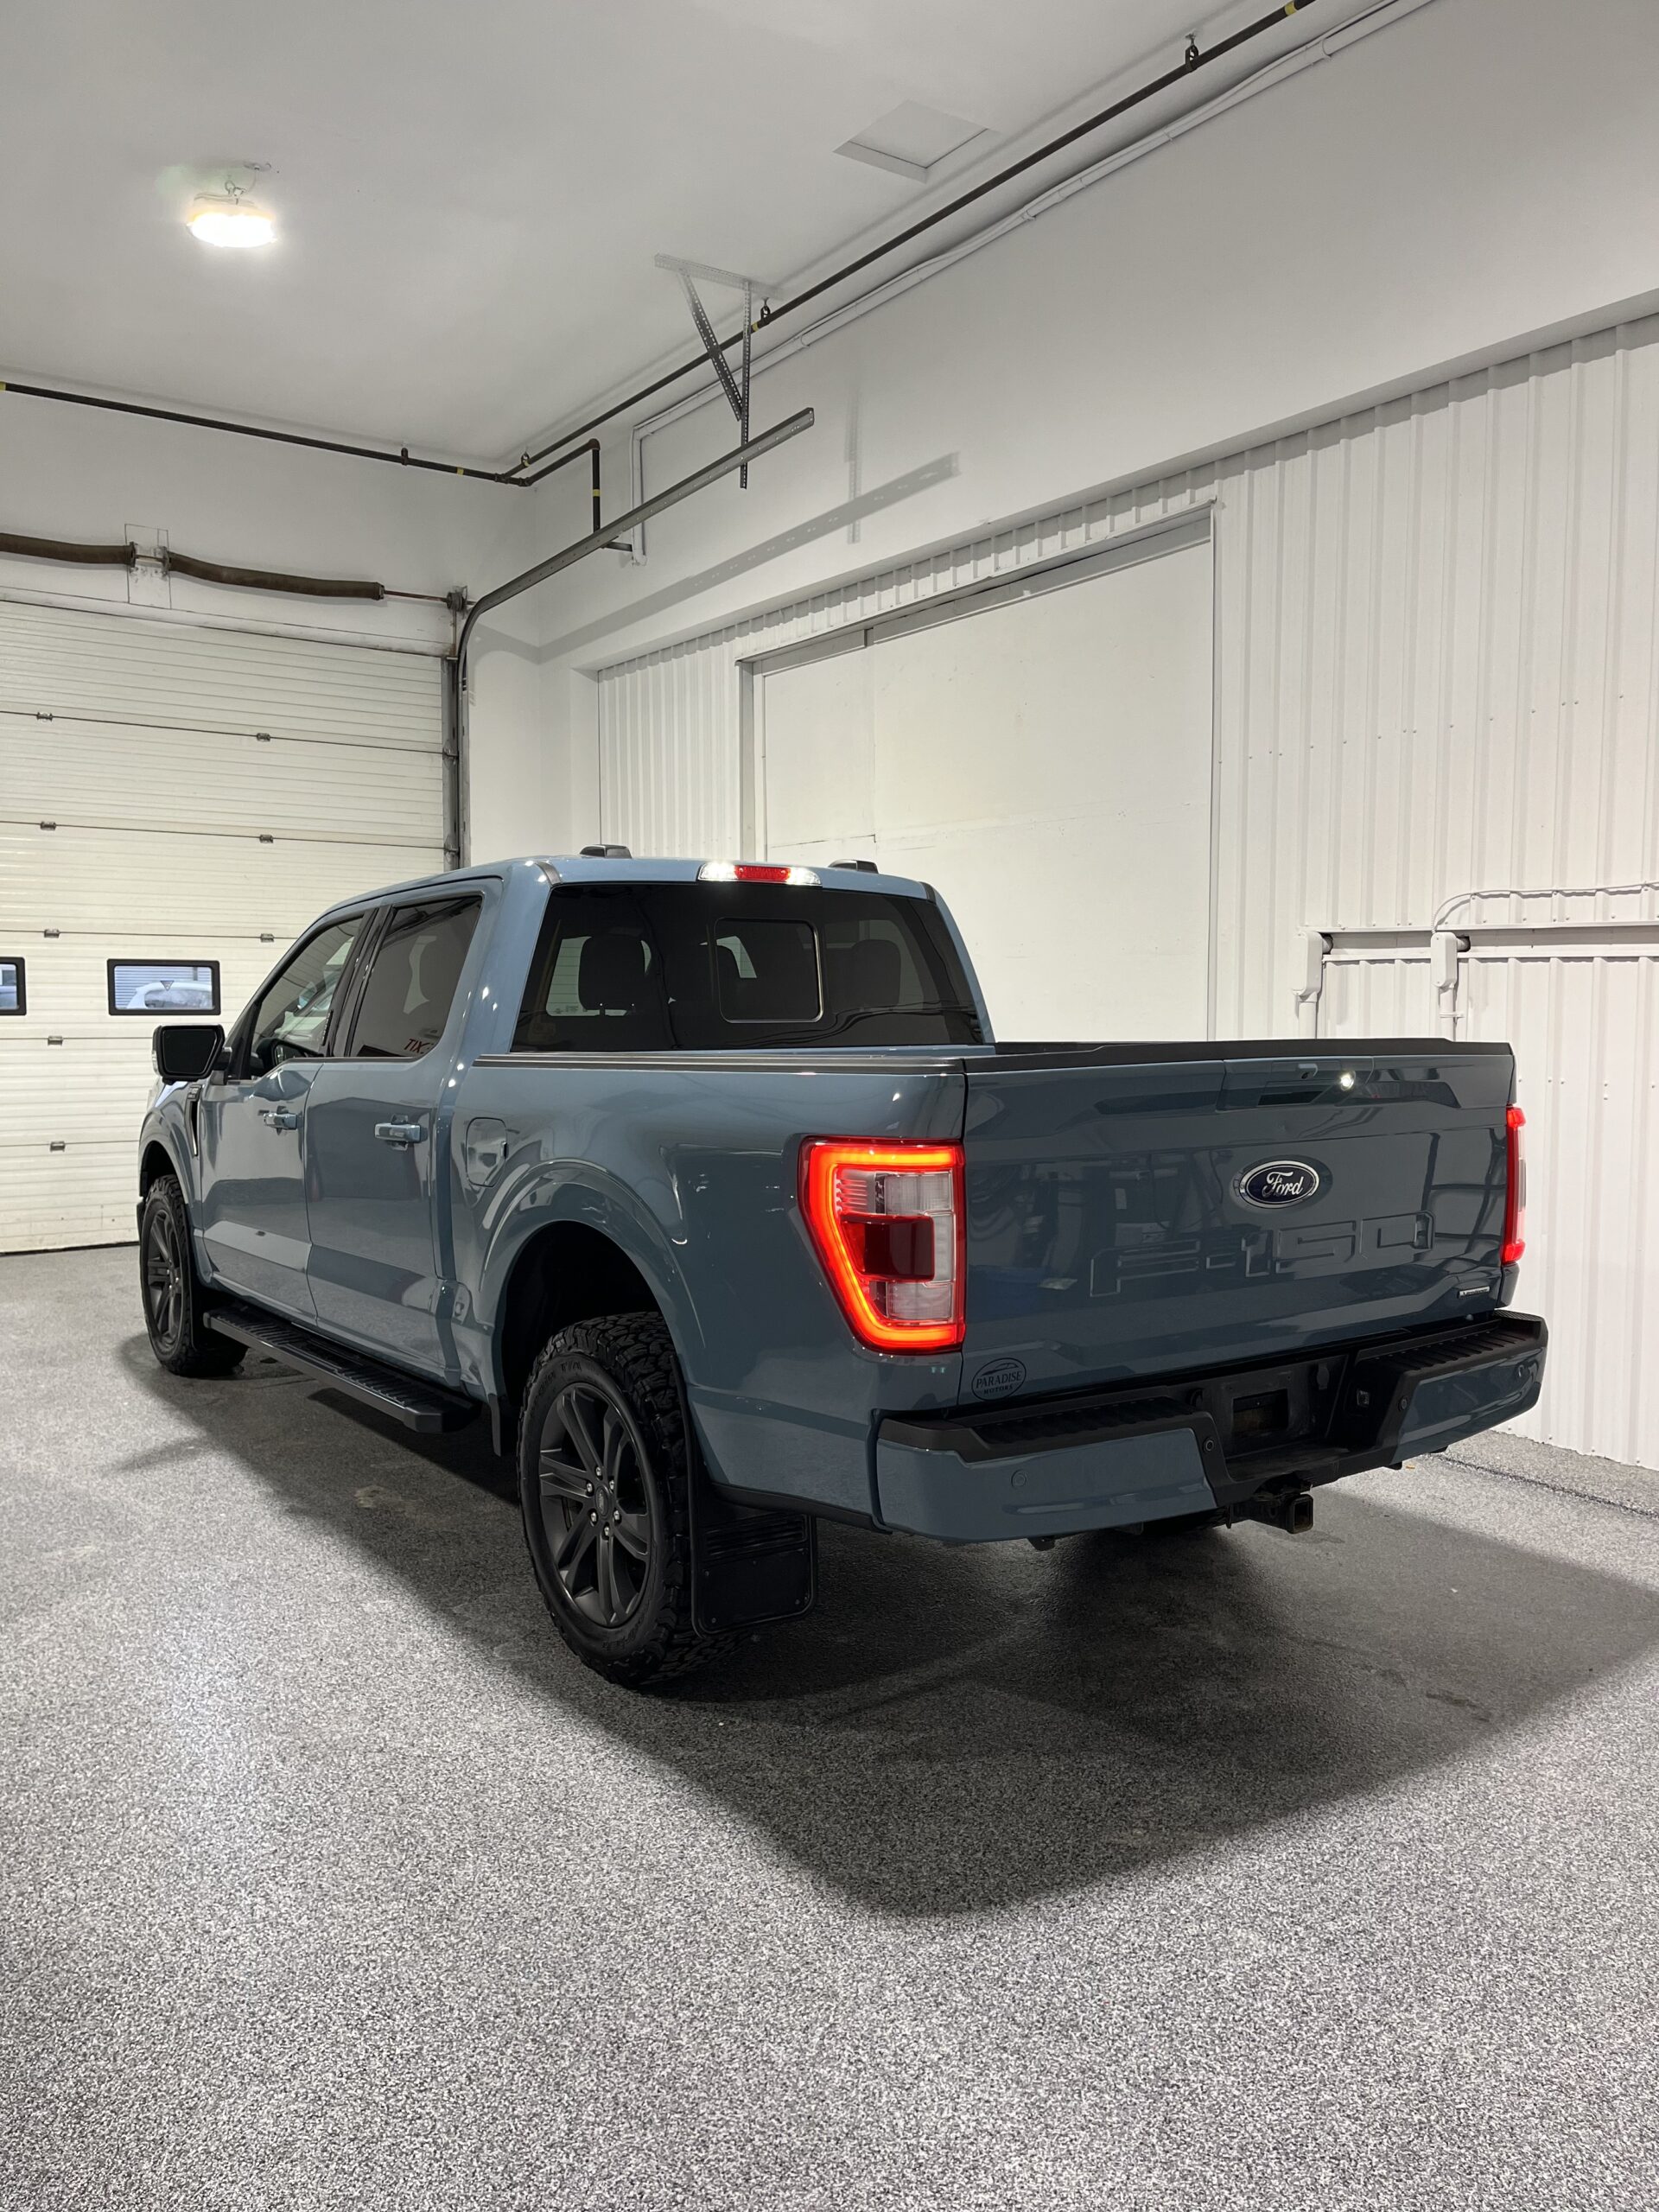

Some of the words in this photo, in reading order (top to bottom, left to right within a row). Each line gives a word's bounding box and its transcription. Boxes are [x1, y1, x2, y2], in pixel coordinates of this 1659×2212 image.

[1262, 1171, 1304, 1198] Ford
[1090, 1211, 1433, 1296] F-150
[976, 1370, 1022, 1389] PARADISE
[983, 1383, 1014, 1395] MOTORS
